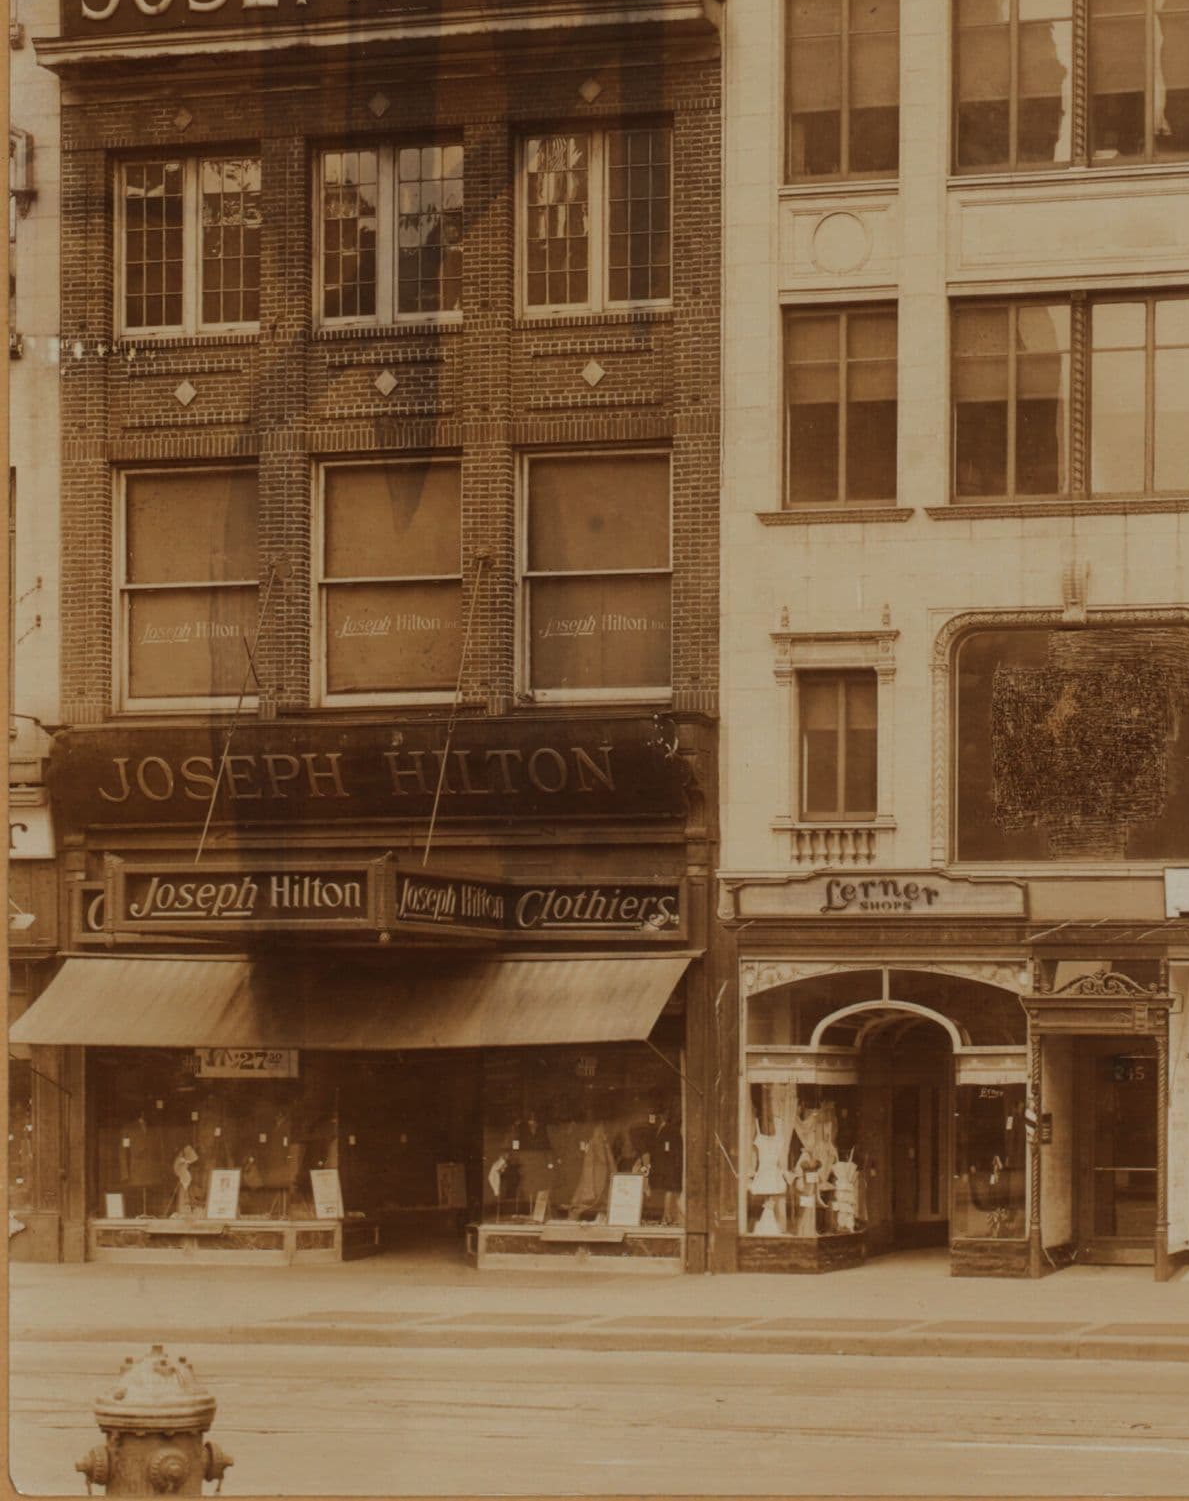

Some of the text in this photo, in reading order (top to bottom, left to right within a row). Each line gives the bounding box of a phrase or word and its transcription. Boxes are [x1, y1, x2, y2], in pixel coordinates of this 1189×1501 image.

[335, 615, 392, 638] Joseph
[98, 746, 617, 803] JOSEPH HILTON
[129, 875, 258, 918] Joseph
[270, 875, 361, 909] Hilton
[399, 877, 457, 921] Joseph
[820, 877, 940, 913] Lerner
[859, 901, 913, 911] SHOPS
